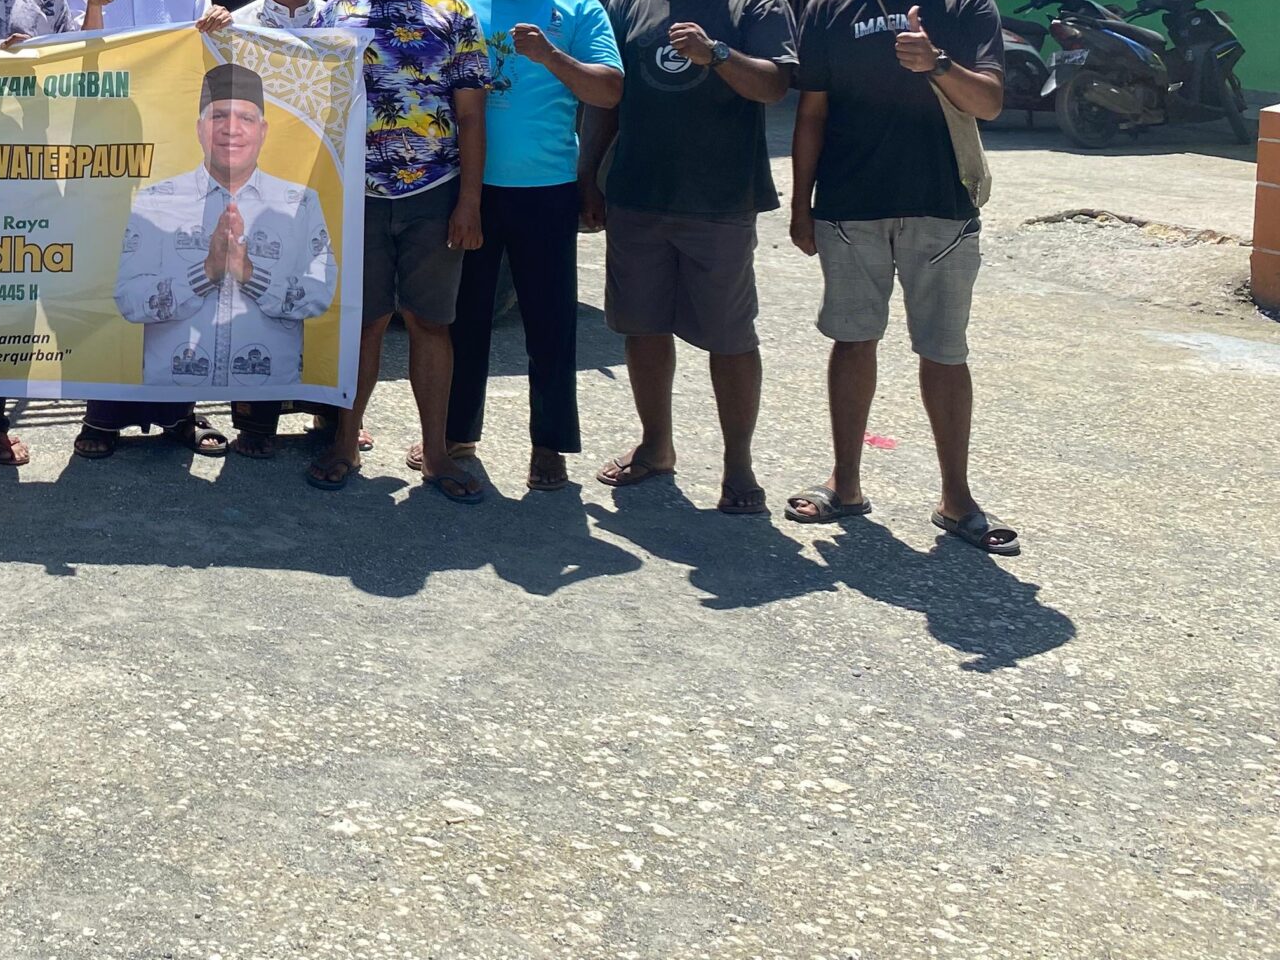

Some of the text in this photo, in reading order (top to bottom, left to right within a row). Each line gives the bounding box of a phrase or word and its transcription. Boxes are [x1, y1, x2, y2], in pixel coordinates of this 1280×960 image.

[854, 13, 922, 39] IMAGIN
[43, 71, 130, 99] QURBAN
[3, 215, 50, 234] Raya
[29, 284, 39, 301] H
